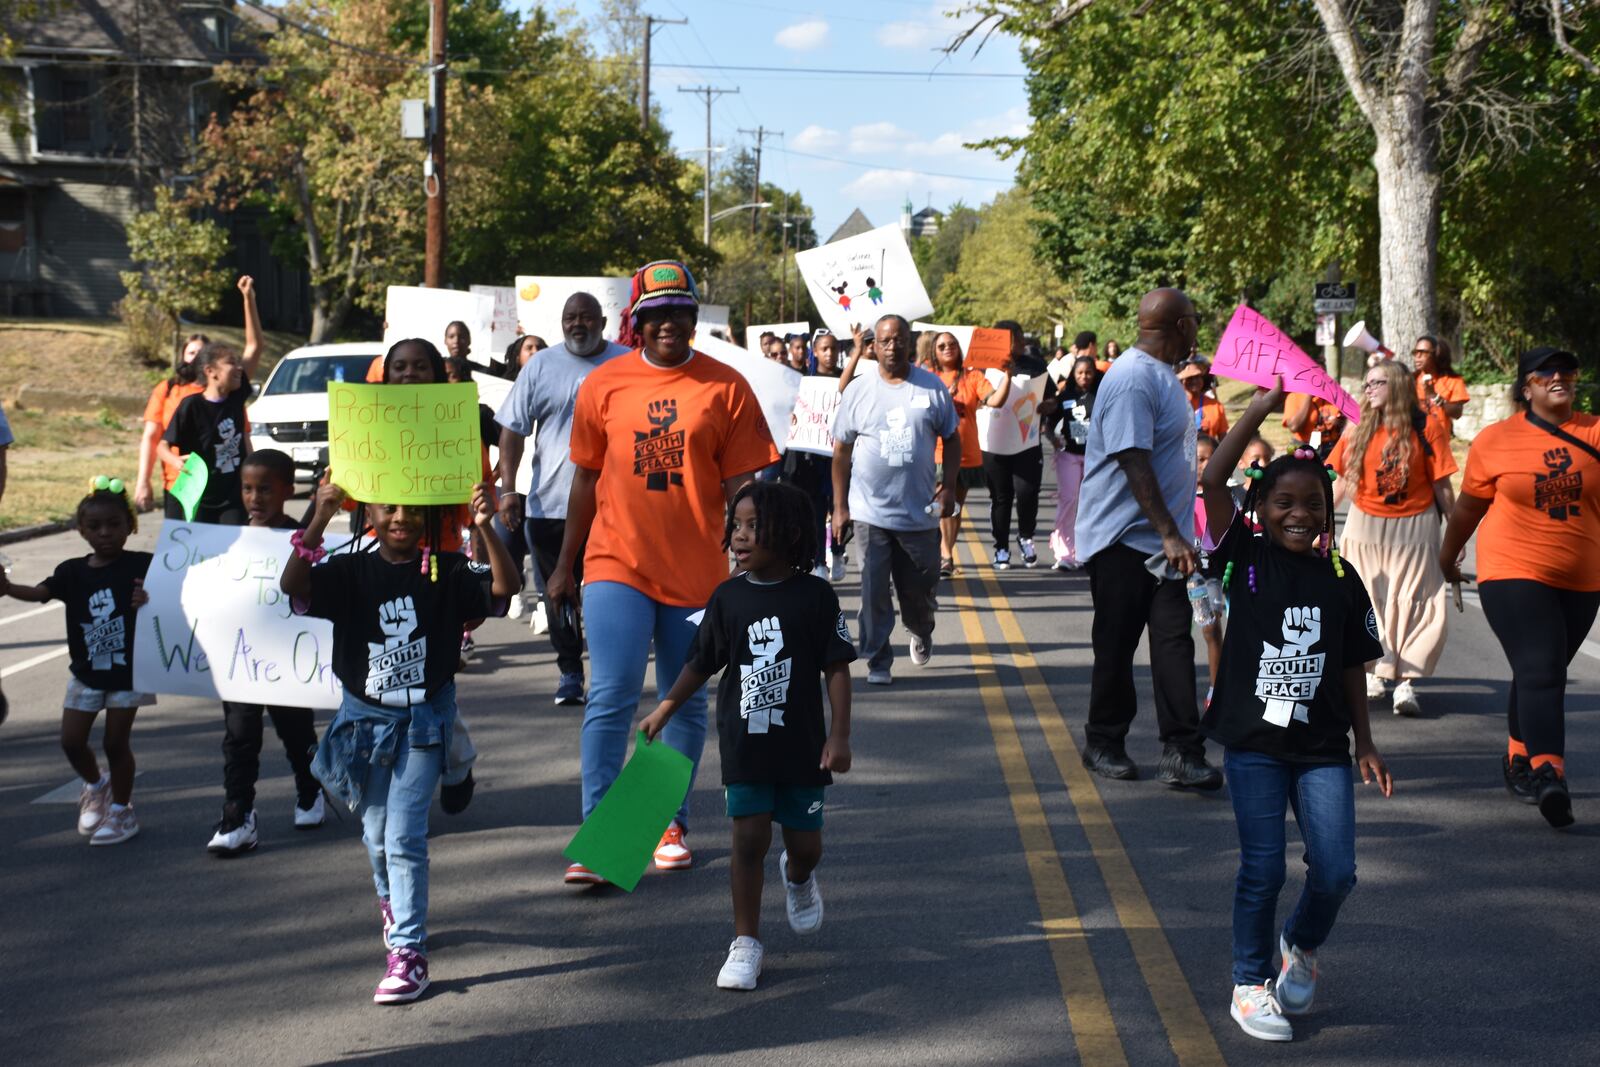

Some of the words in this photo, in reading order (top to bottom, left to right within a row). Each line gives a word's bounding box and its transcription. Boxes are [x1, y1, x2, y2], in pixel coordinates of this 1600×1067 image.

[1219, 336, 1288, 376] SAFE
[335, 388, 424, 425] Protect
[433, 399, 467, 423] our
[400, 424, 477, 464] Protect
[640, 434, 680, 454] YOUTH
[640, 454, 680, 470] PEACE
[344, 468, 391, 494] our
[152, 615, 211, 674] We
[228, 627, 282, 683] Are
[372, 643, 422, 673] YOUTH
[743, 663, 787, 692] YOUTH
[1265, 657, 1320, 675] YOUTH
[373, 667, 420, 692] PEACE
[1263, 681, 1311, 697] PEACE
[743, 687, 784, 711] PEACE
